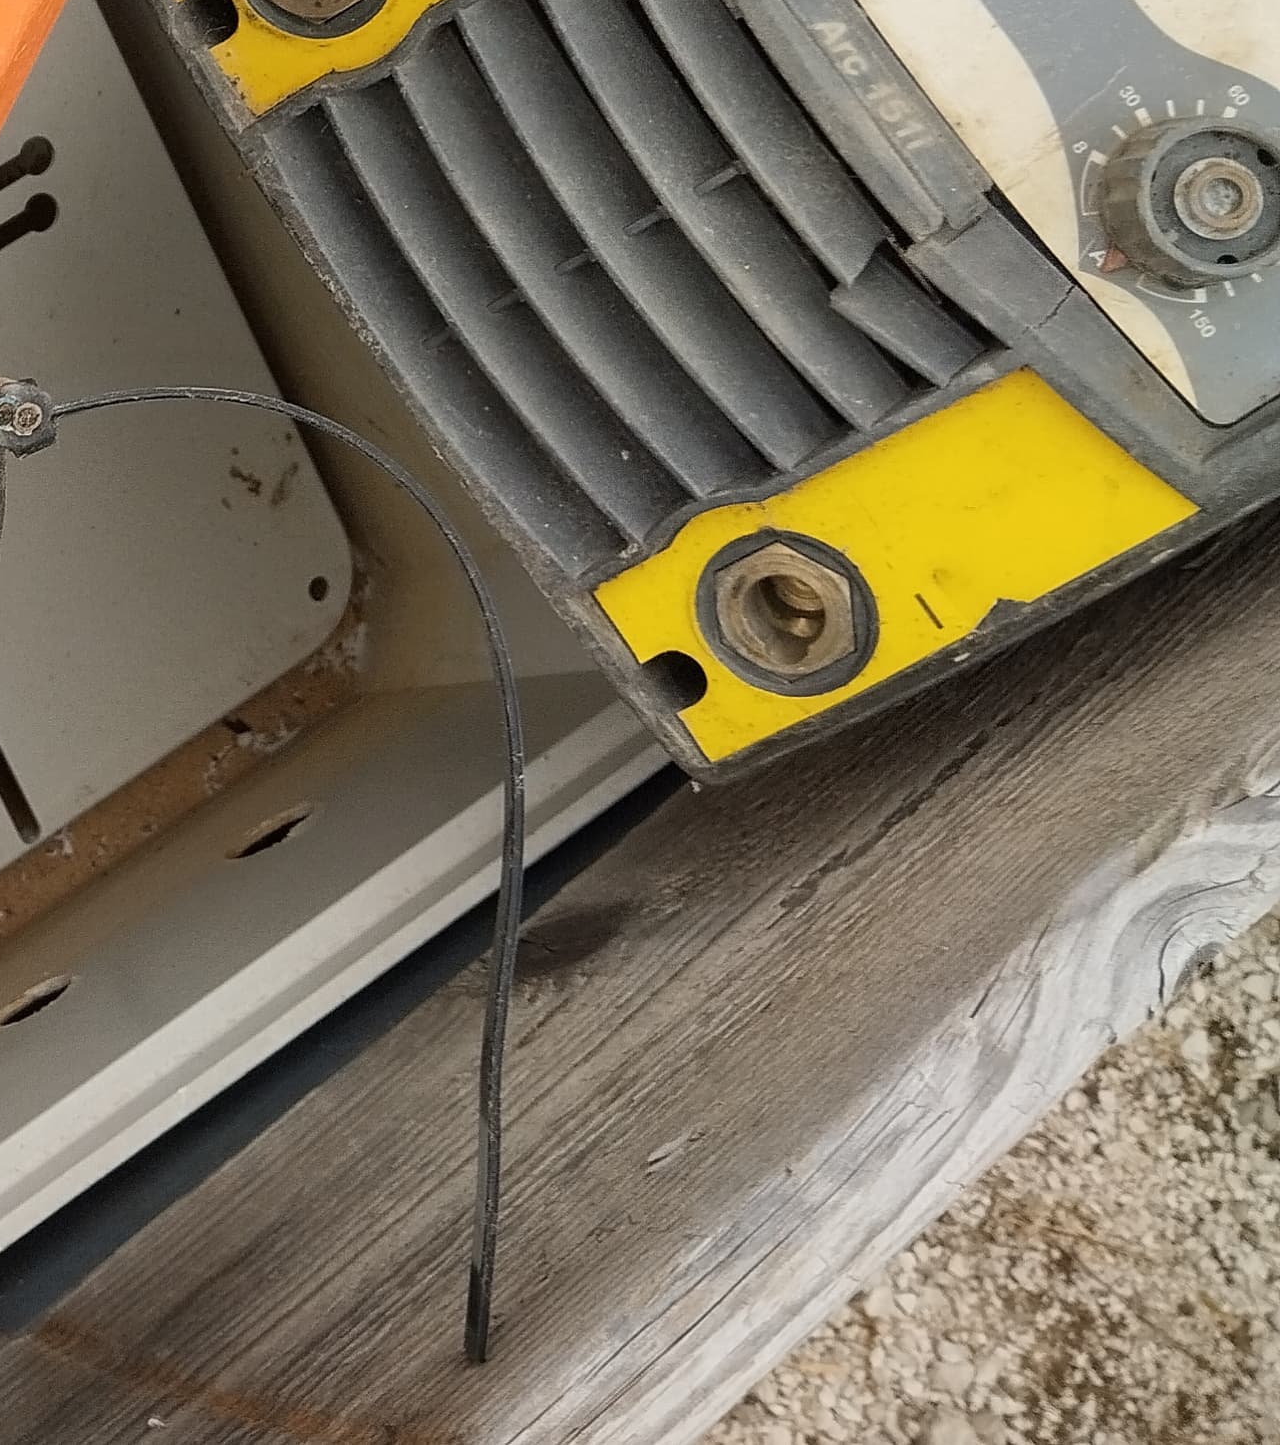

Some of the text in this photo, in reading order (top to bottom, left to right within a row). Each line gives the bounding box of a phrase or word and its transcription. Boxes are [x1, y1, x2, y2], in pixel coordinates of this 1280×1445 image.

[806, 21, 869, 76] Arc
[1119, 85, 1142, 107] 30
[1228, 85, 1251, 106] 60
[1073, 139, 1088, 154] 8
